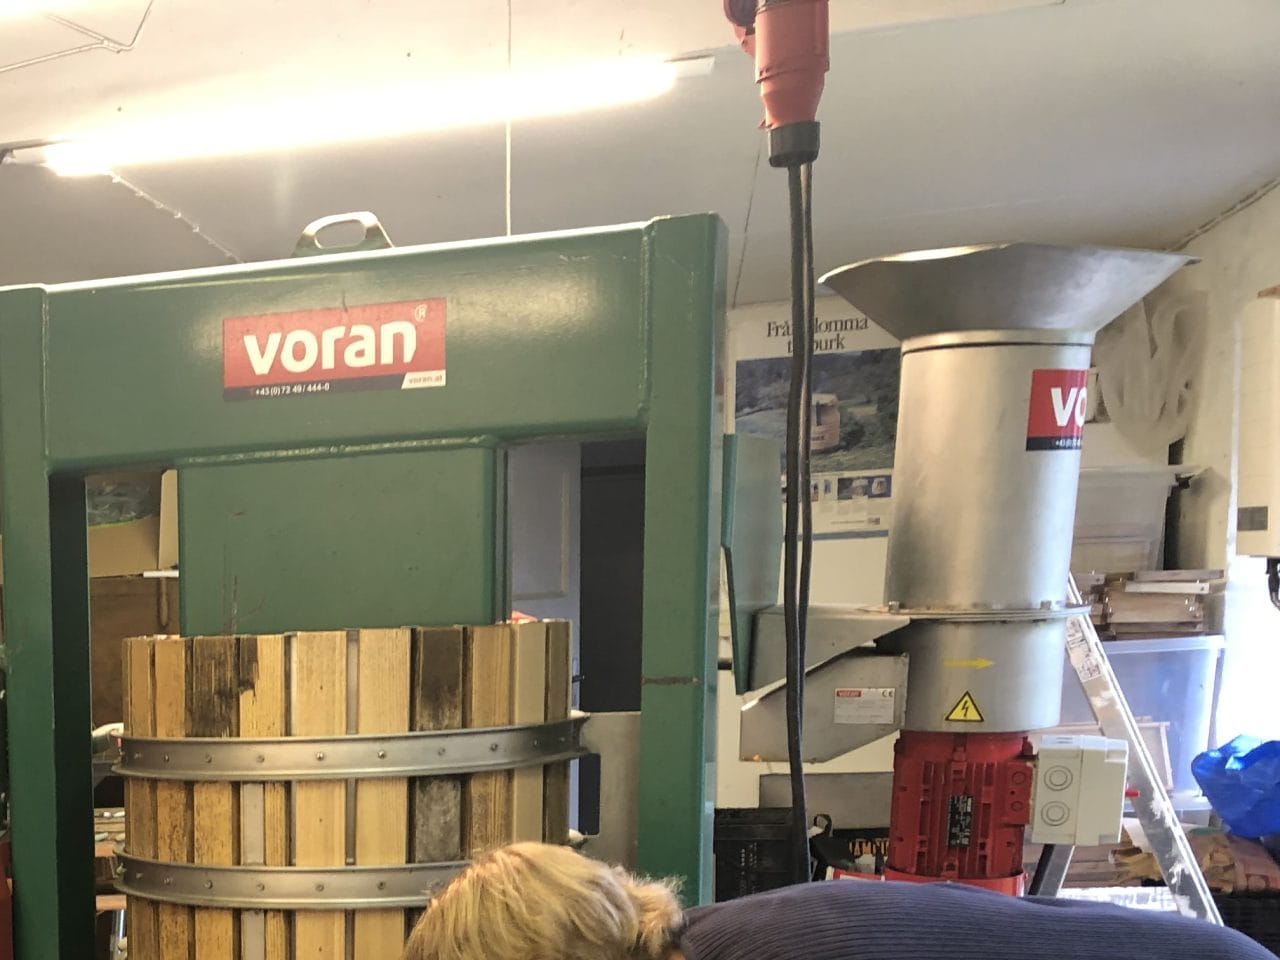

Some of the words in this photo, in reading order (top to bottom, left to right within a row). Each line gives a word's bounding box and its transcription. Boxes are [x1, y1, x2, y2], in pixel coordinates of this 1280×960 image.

[243, 320, 417, 376] voran
[767, 320, 793, 338] Frå
[814, 317, 869, 334] lomma
[1051, 386, 1088, 428] vo
